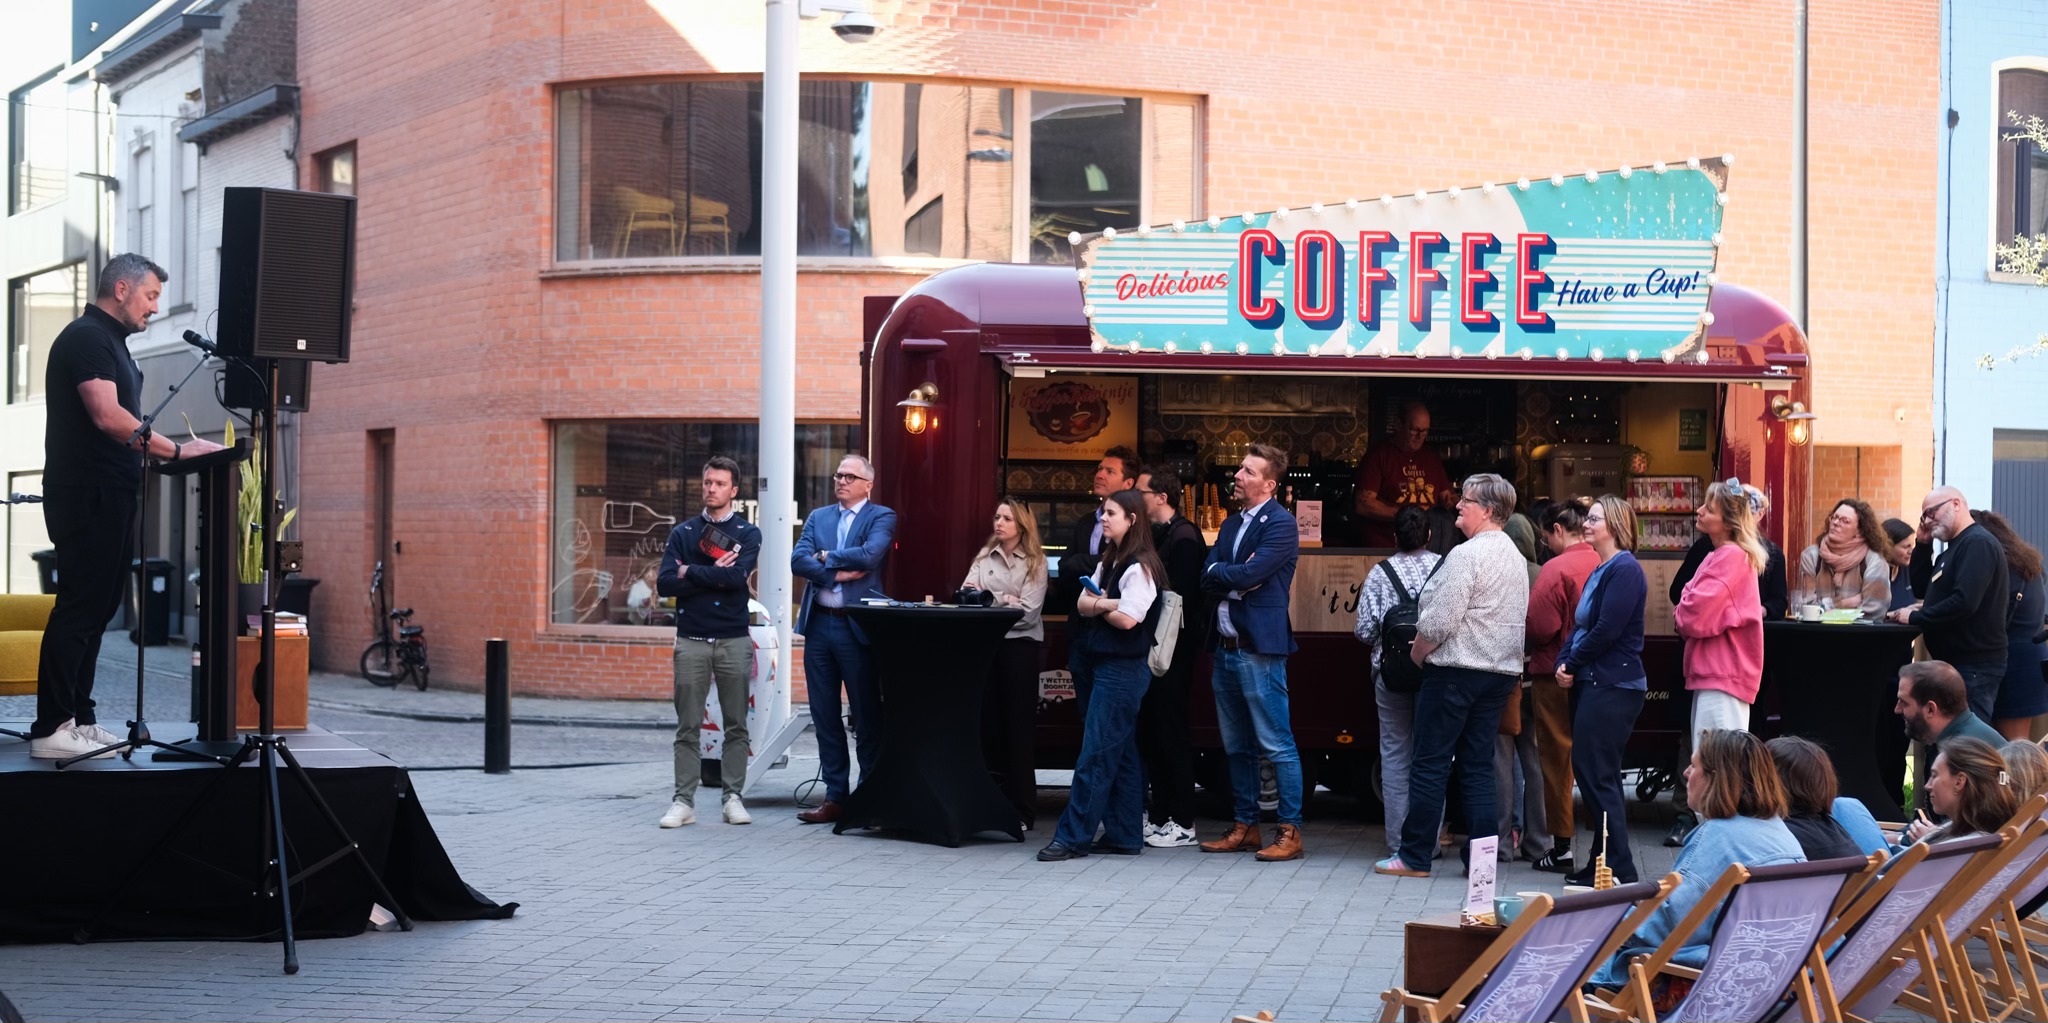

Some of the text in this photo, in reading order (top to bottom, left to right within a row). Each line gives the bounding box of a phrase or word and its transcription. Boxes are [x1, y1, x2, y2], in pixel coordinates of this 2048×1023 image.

[1115, 229, 1700, 332] Delicious COFFEE Have a Cup!
[1176, 383, 1338, 407] COFFEE & TEA
[732, 500, 744, 512] DE
